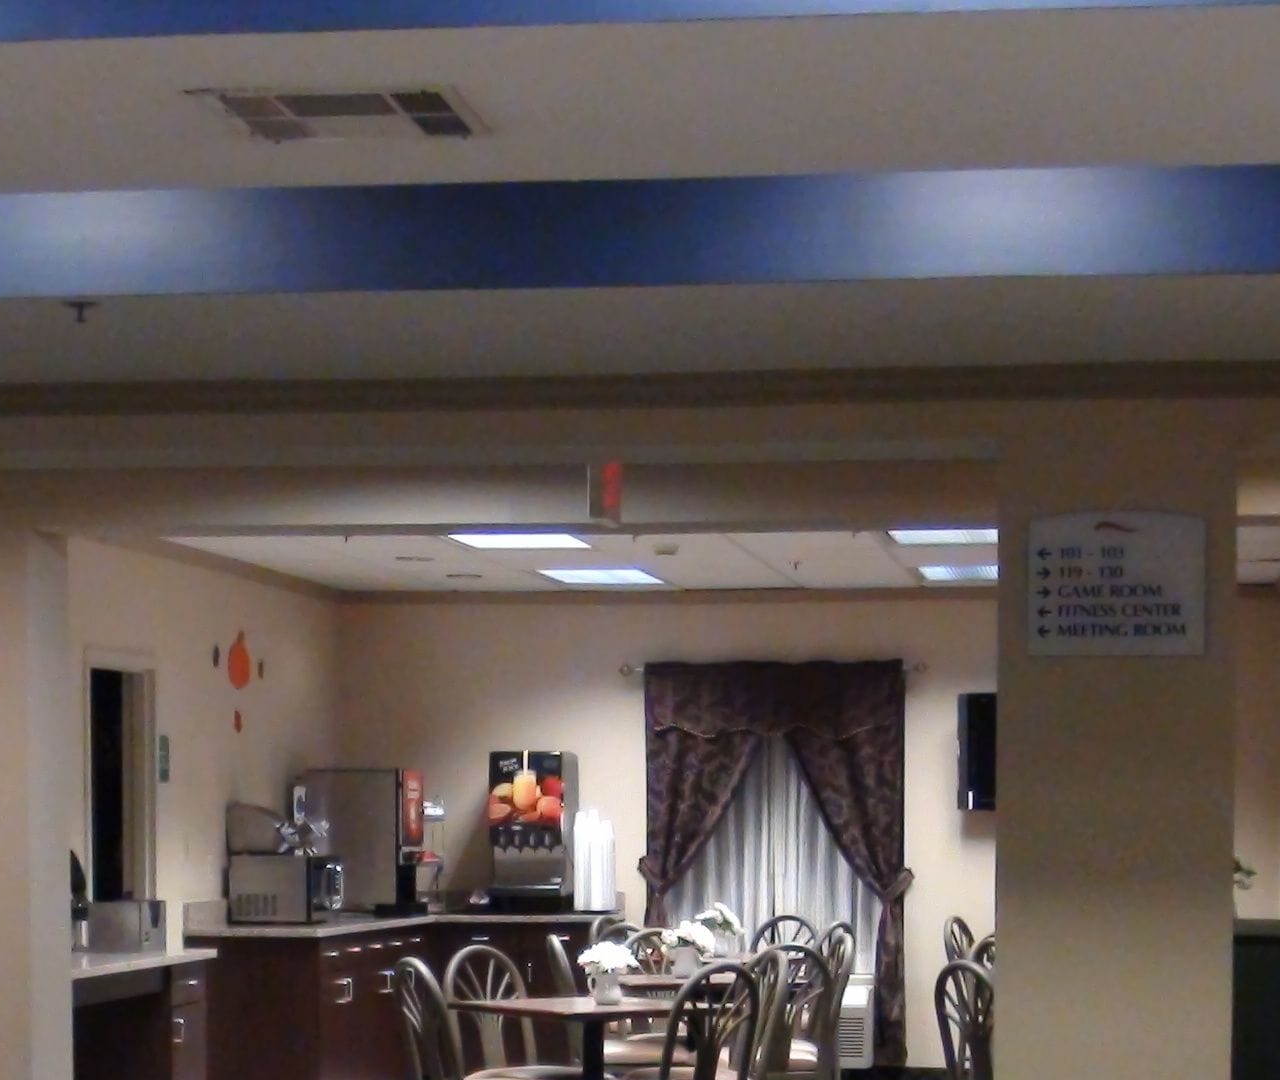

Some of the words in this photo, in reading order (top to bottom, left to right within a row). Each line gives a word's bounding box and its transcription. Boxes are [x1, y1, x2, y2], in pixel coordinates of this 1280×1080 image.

[1057, 584, 1104, 598] GAME
[1109, 585, 1162, 598] ROOM
[1057, 603, 1116, 617] FITNESS
[1120, 603, 1182, 617] CENTER
[1056, 623, 1129, 637] MEETING
[1133, 624, 1187, 637] ROOM
